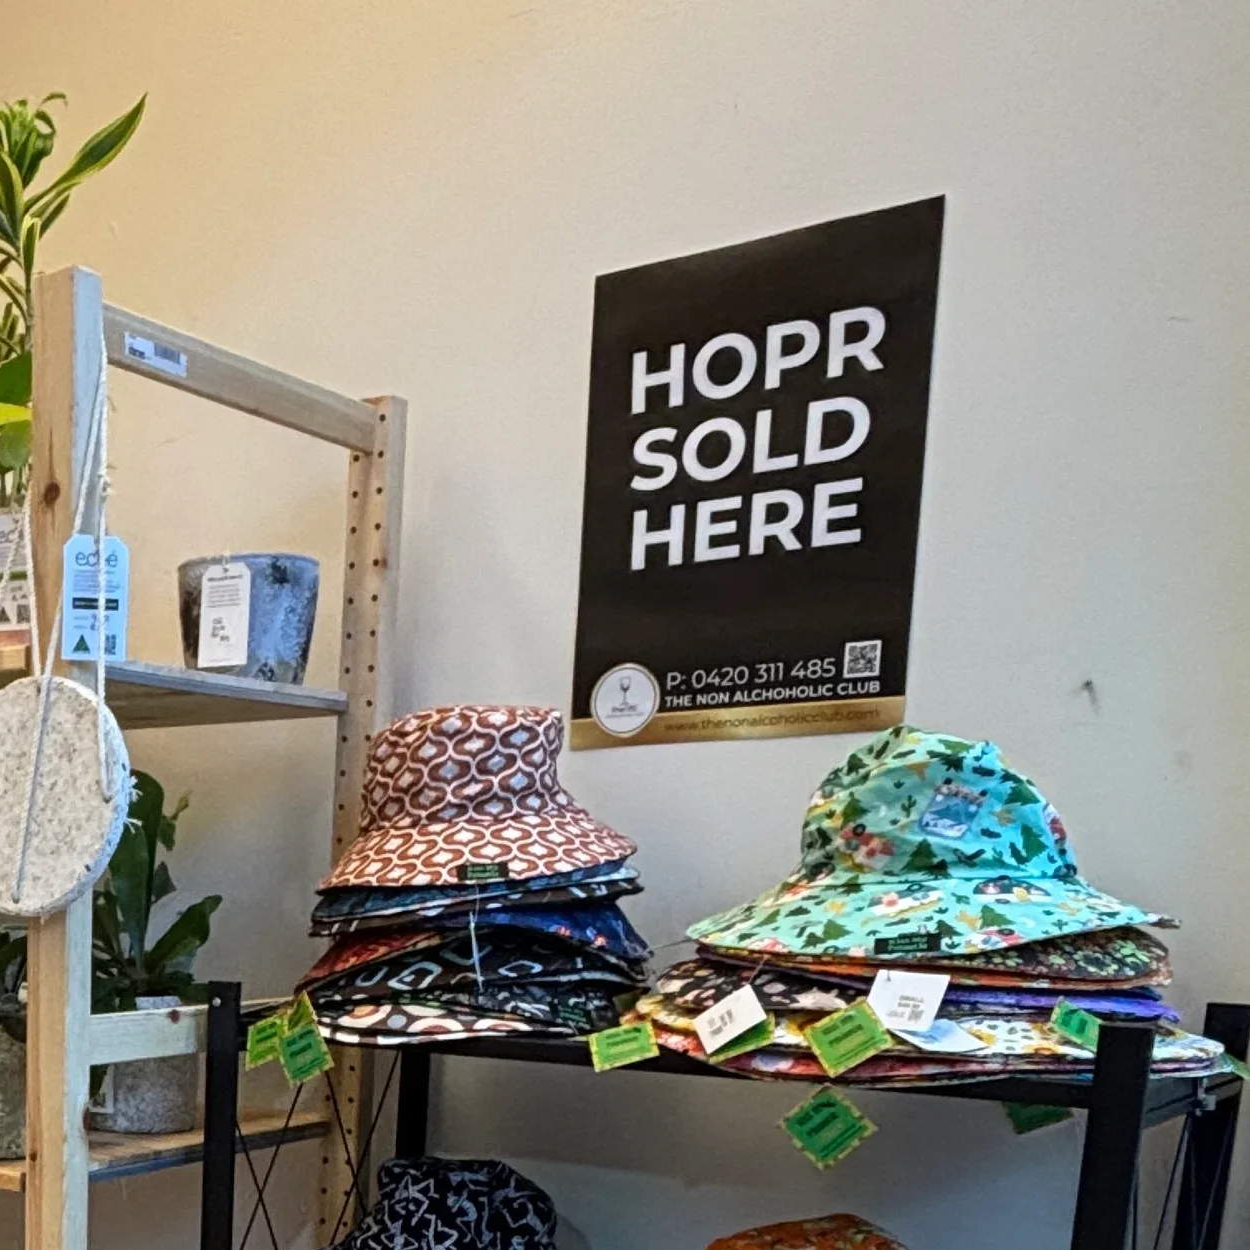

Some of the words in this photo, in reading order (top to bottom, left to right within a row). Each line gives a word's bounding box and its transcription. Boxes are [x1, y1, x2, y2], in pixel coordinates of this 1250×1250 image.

[630, 306, 887, 415] HOPR
[630, 396, 871, 491] SOLD
[630, 478, 863, 571] HERE
[664, 694, 693, 708] THE
[696, 691, 730, 706] NON
[734, 683, 834, 703] ALCHOHOLIC
[837, 680, 881, 696] CLUB
[666, 671, 687, 691] P:
[691, 665, 749, 689] 0420
[753, 662, 784, 683] 311
[790, 657, 836, 679] 485
